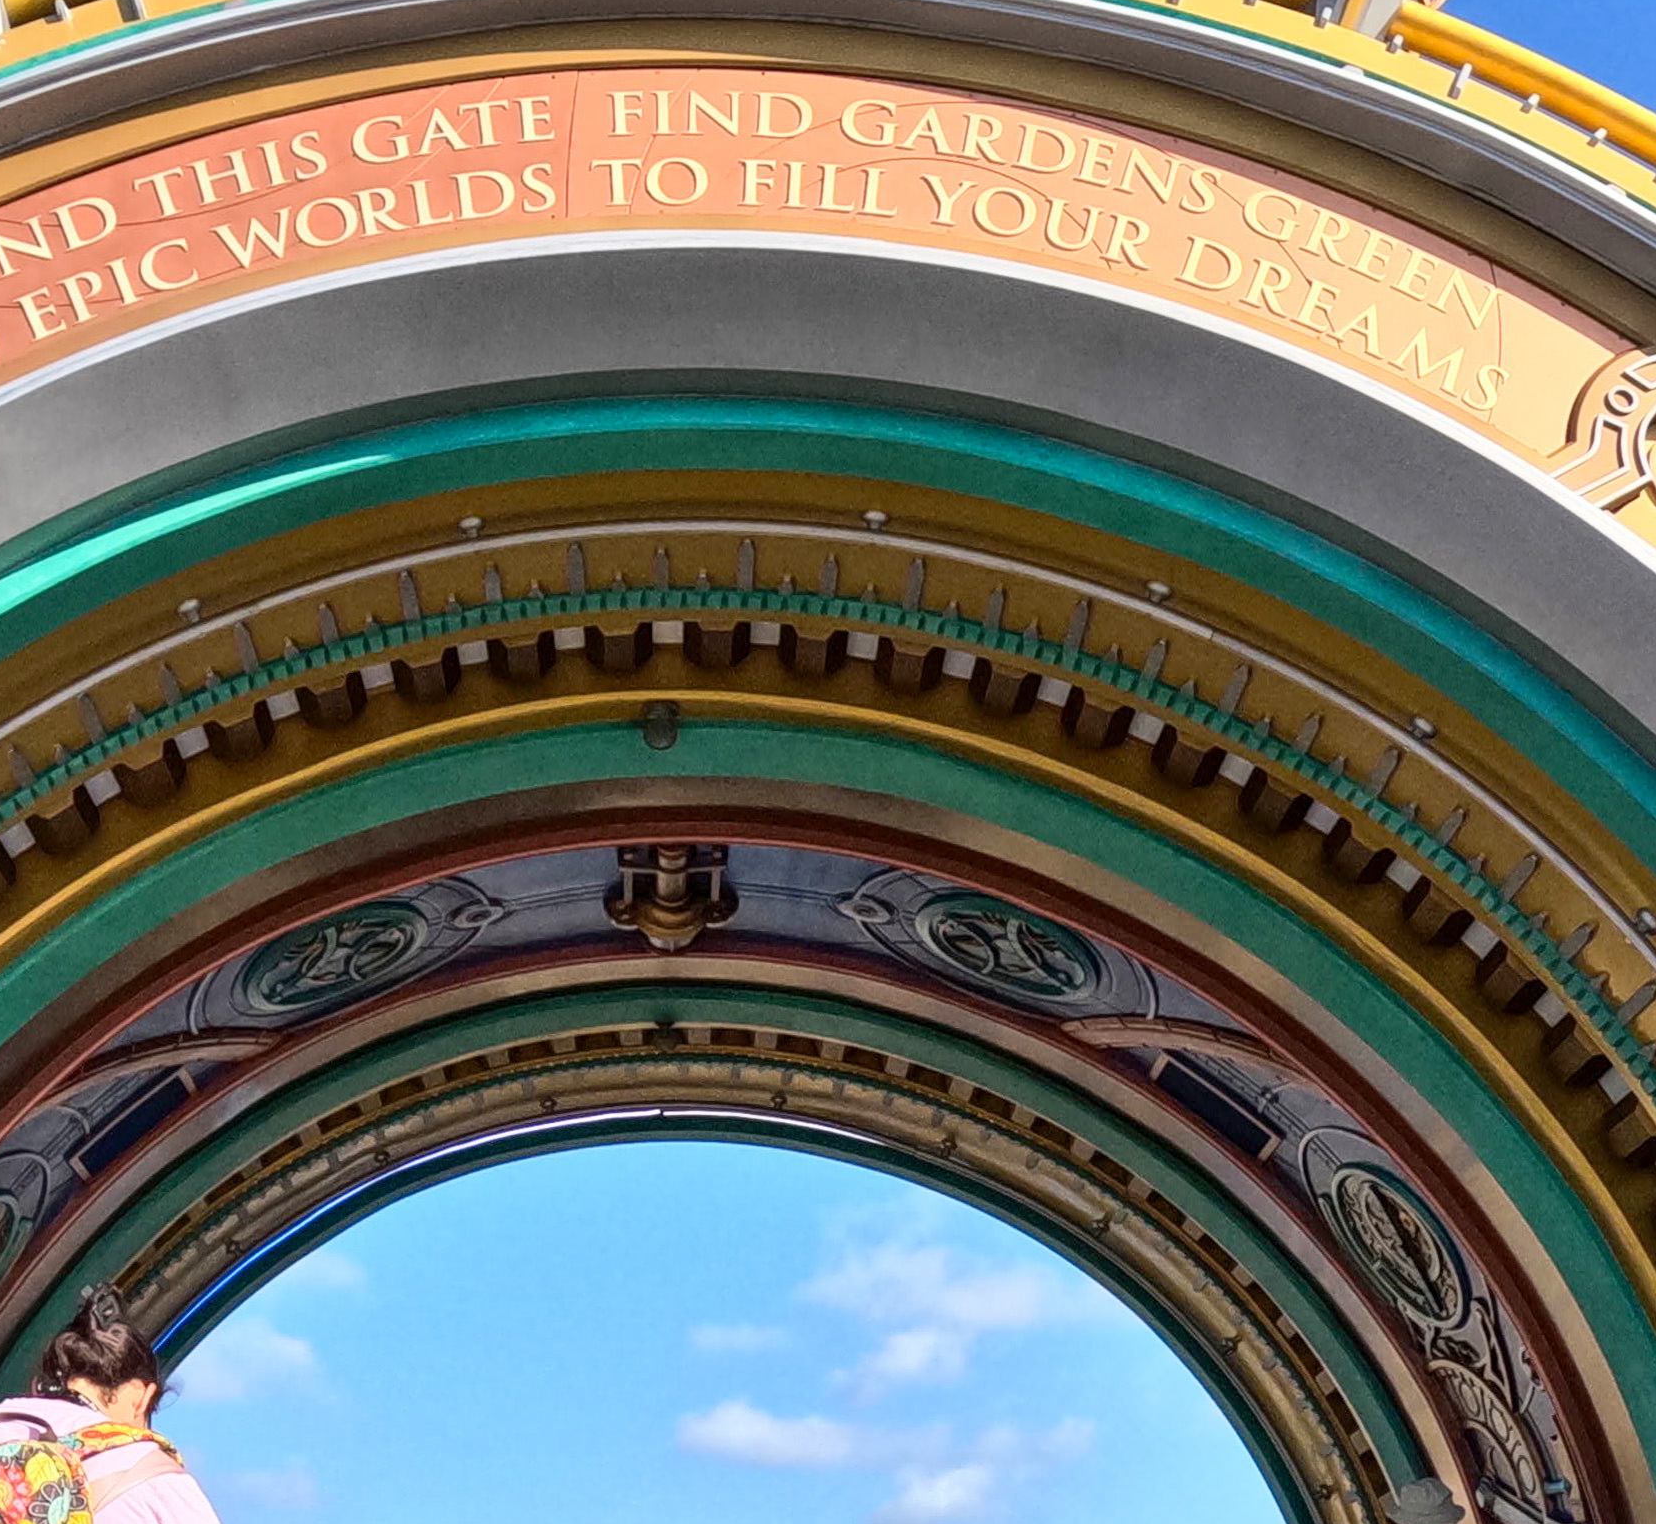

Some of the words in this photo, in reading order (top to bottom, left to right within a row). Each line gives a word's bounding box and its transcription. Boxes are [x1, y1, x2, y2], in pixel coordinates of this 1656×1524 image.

[13, 238, 199, 342] EPIC
[211, 162, 557, 269] WORLDS
[591, 157, 709, 208] TO
[738, 159, 899, 218] FILL
[920, 174, 1150, 271] YOUR
[1175, 235, 1511, 413] DREAMS
[133, 130, 328, 219] THIS
[351, 95, 556, 165] GATE
[606, 90, 814, 139] FIND
[840, 99, 1222, 215] GARDENS
[1242, 189, 1502, 330] GREEN
